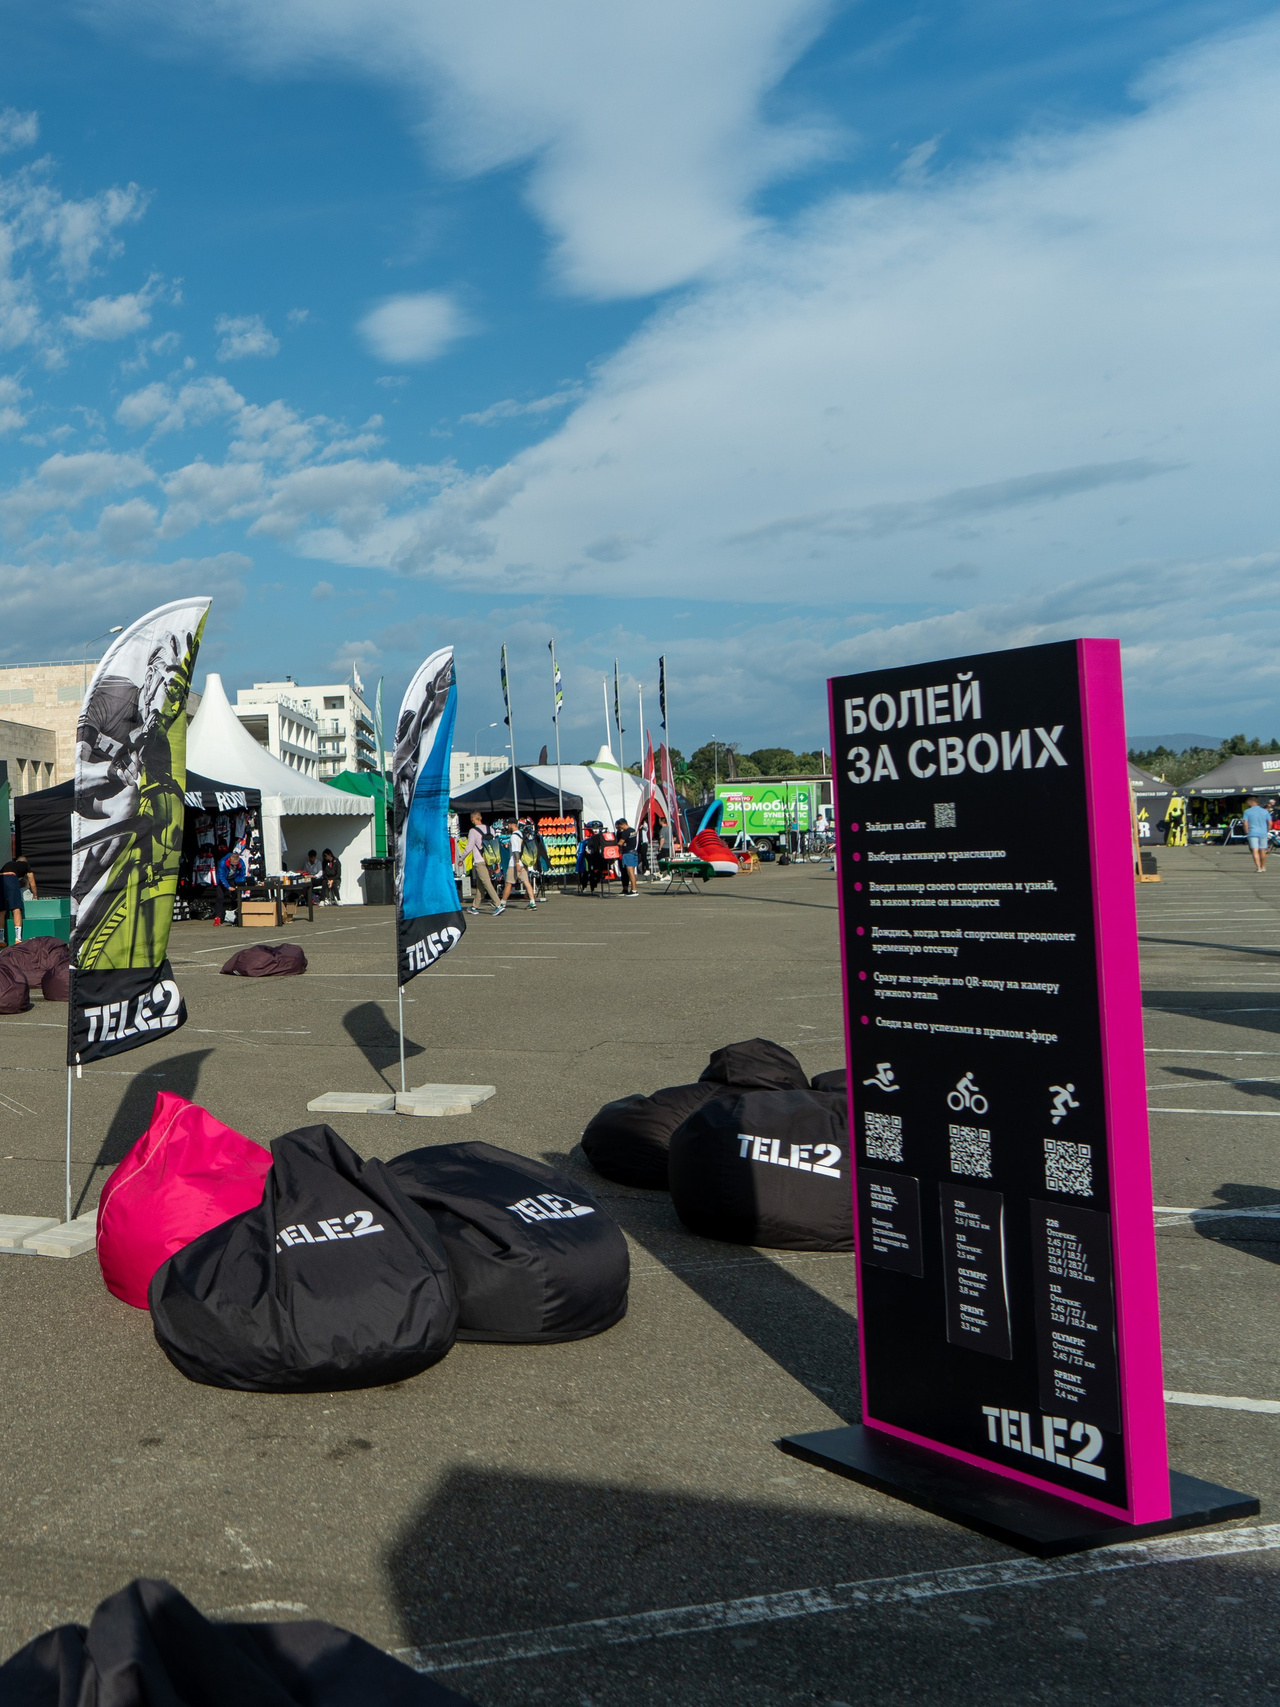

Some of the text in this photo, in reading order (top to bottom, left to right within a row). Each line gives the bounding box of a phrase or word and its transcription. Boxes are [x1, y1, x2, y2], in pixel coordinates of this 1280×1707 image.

[844, 671, 982, 735] БОЛЕЙ
[846, 725, 1068, 784] ЗА СВОИХ
[866, 820, 926, 832] Зайди на сайт
[868, 850, 1006, 863] Выбери активную трансляцию
[869, 880, 1057, 893] Введи номер своего спортсмена и узнай,
[870, 899, 1000, 908] на каком этапе он находится
[871, 927, 1076, 943] Дождись, когда твой спортсмен преодолеет
[406, 926, 461, 971] TELE2
[872, 944, 959, 956] временную отсечку
[874, 971, 1060, 995] Сразу же перейди по QR-коду на камеру
[874, 988, 938, 1000] нужного этапа
[84, 980, 180, 1042] TELE2
[876, 1016, 1058, 1044] Следи за его успехами в прямом эфире
[737, 1134, 842, 1179] TELE2
[982, 1405, 1106, 1481] TELE2
